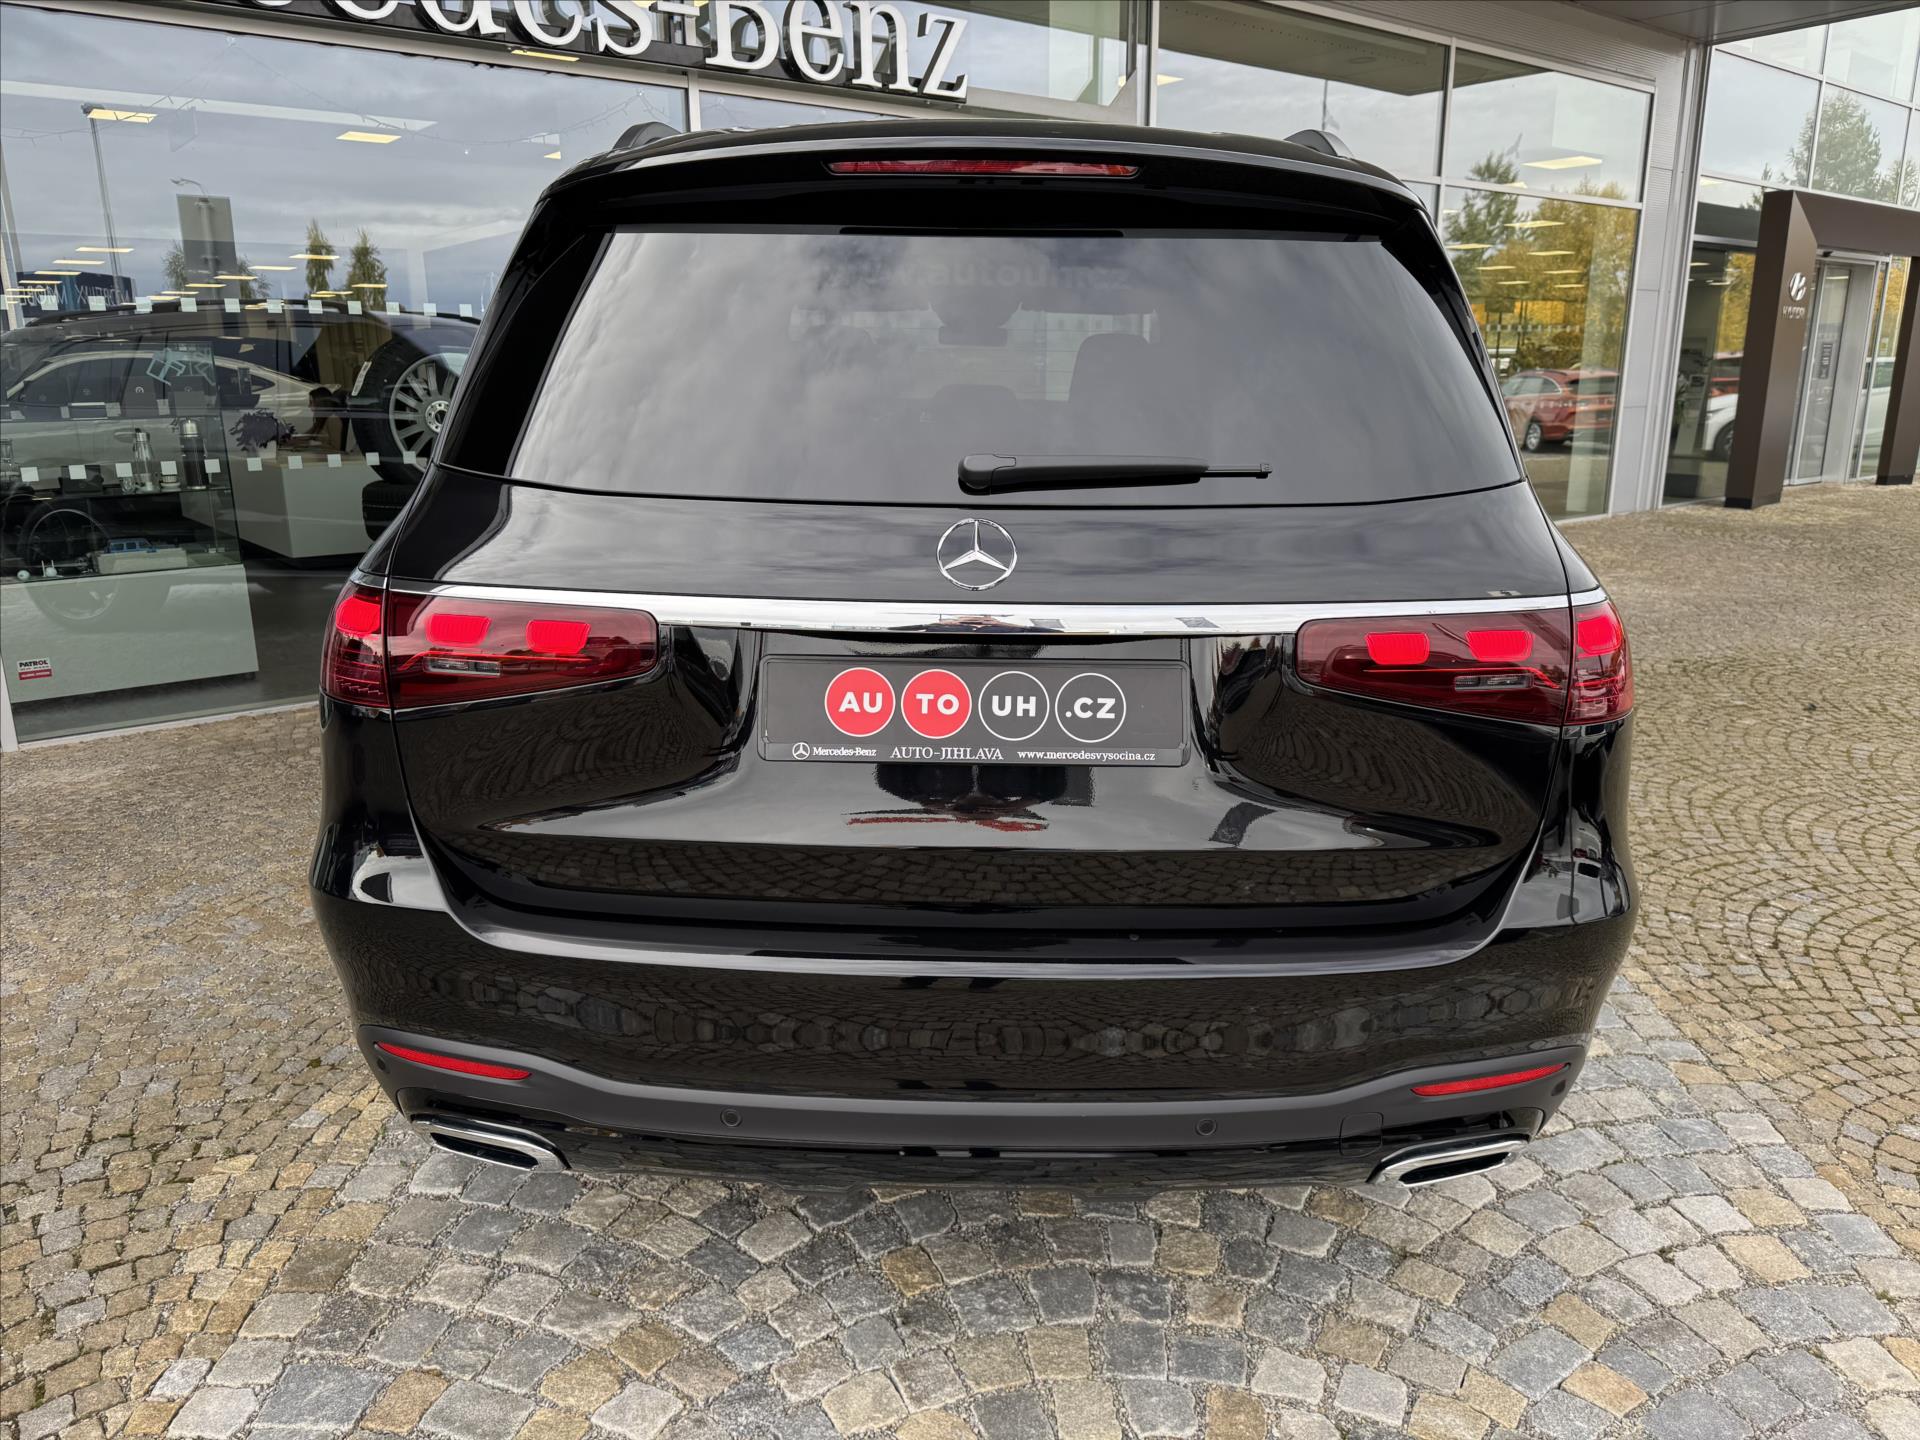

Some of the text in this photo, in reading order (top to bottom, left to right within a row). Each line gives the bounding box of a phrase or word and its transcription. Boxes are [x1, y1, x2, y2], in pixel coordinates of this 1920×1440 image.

[838, 691, 1116, 719] AU TO UH .CZ
[812, 746, 1156, 762] Mercedes-Benz AUTO-JIHLAVA www.mercedesvysocina.cz
